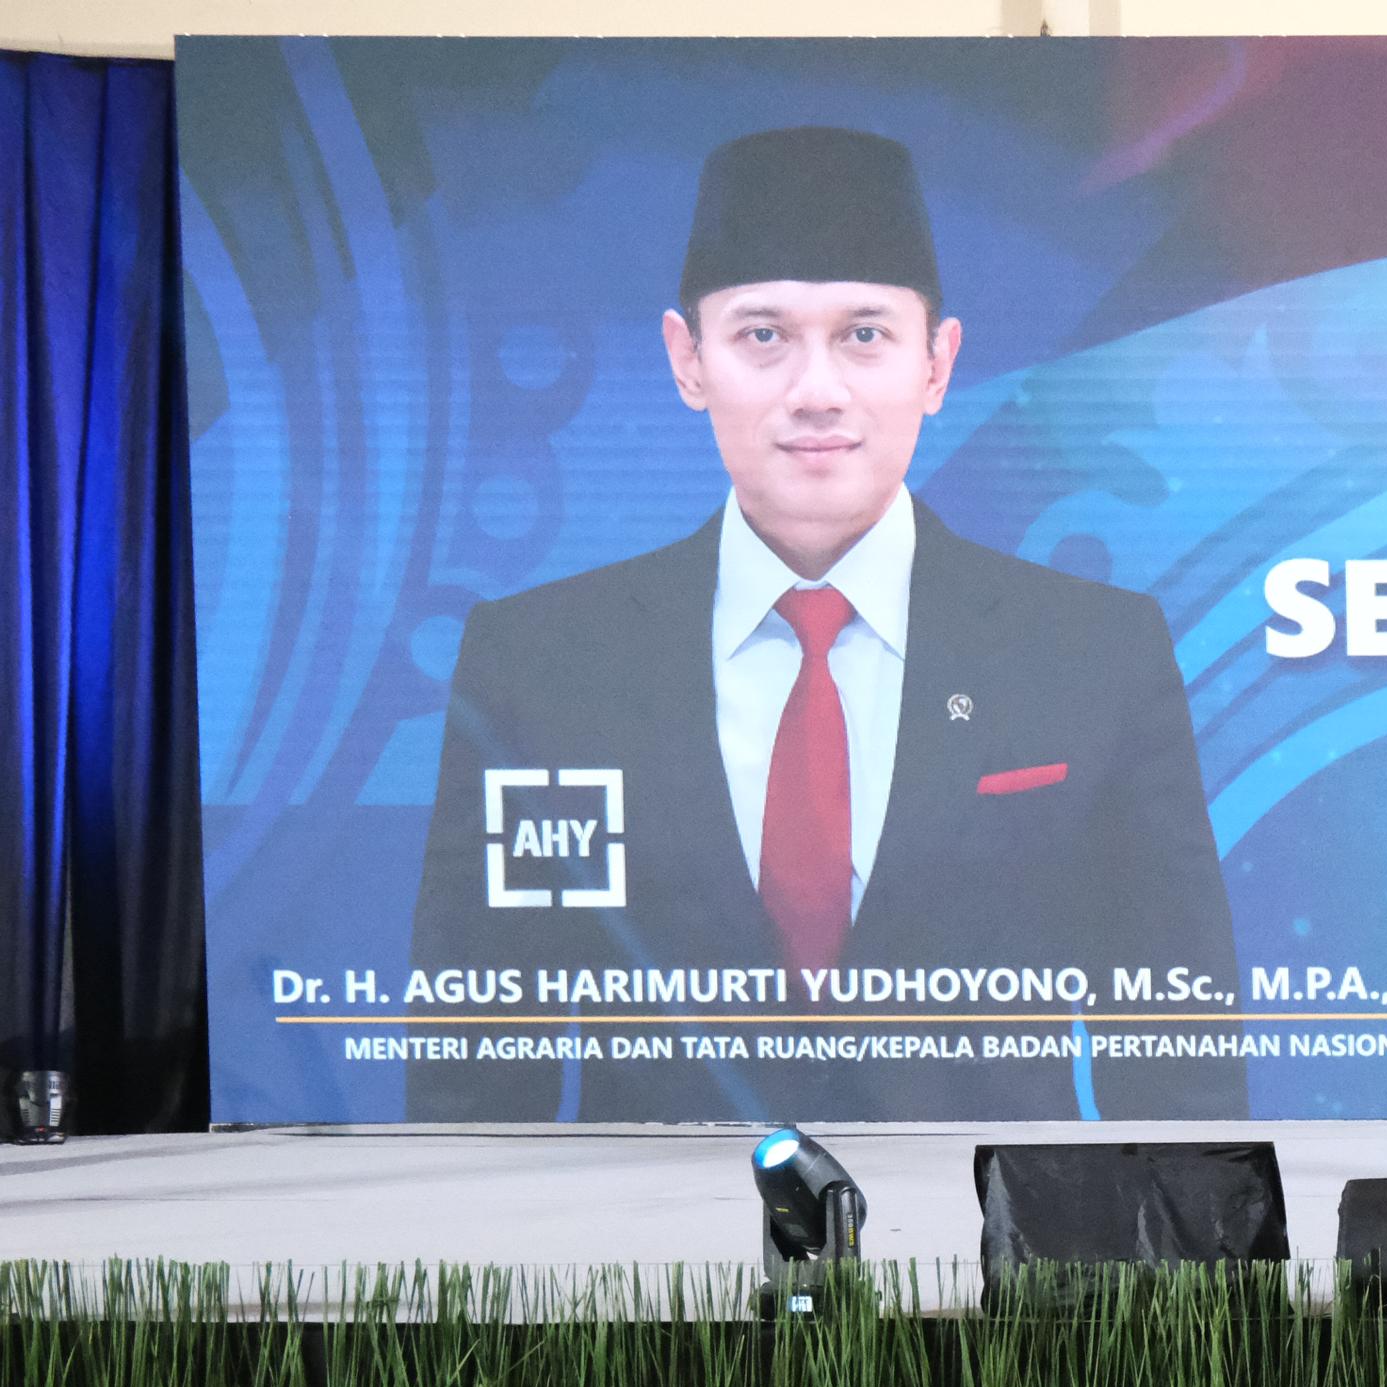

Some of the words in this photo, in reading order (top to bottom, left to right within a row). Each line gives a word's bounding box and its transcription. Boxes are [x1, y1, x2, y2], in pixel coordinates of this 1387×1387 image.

[513, 819, 598, 857] AHY
[274, 970, 330, 1003] Dr.
[346, 970, 390, 1003] H.
[404, 969, 523, 1004] AGUS
[538, 968, 787, 1003] HARIMURTI
[800, 967, 1097, 1006] YUDHOYONO,
[1114, 966, 1235, 1006] M.Sc.,
[345, 1037, 468, 1060] MENTERI
[476, 1037, 603, 1060] AGRARIA
[612, 1037, 673, 1059] DAN
[681, 1036, 749, 1059] TATA
[757, 1036, 975, 1062] RUANG/KEPALA
[983, 1035, 1082, 1058] BADAN
[1092, 1035, 1280, 1057] PERTANAHAN
